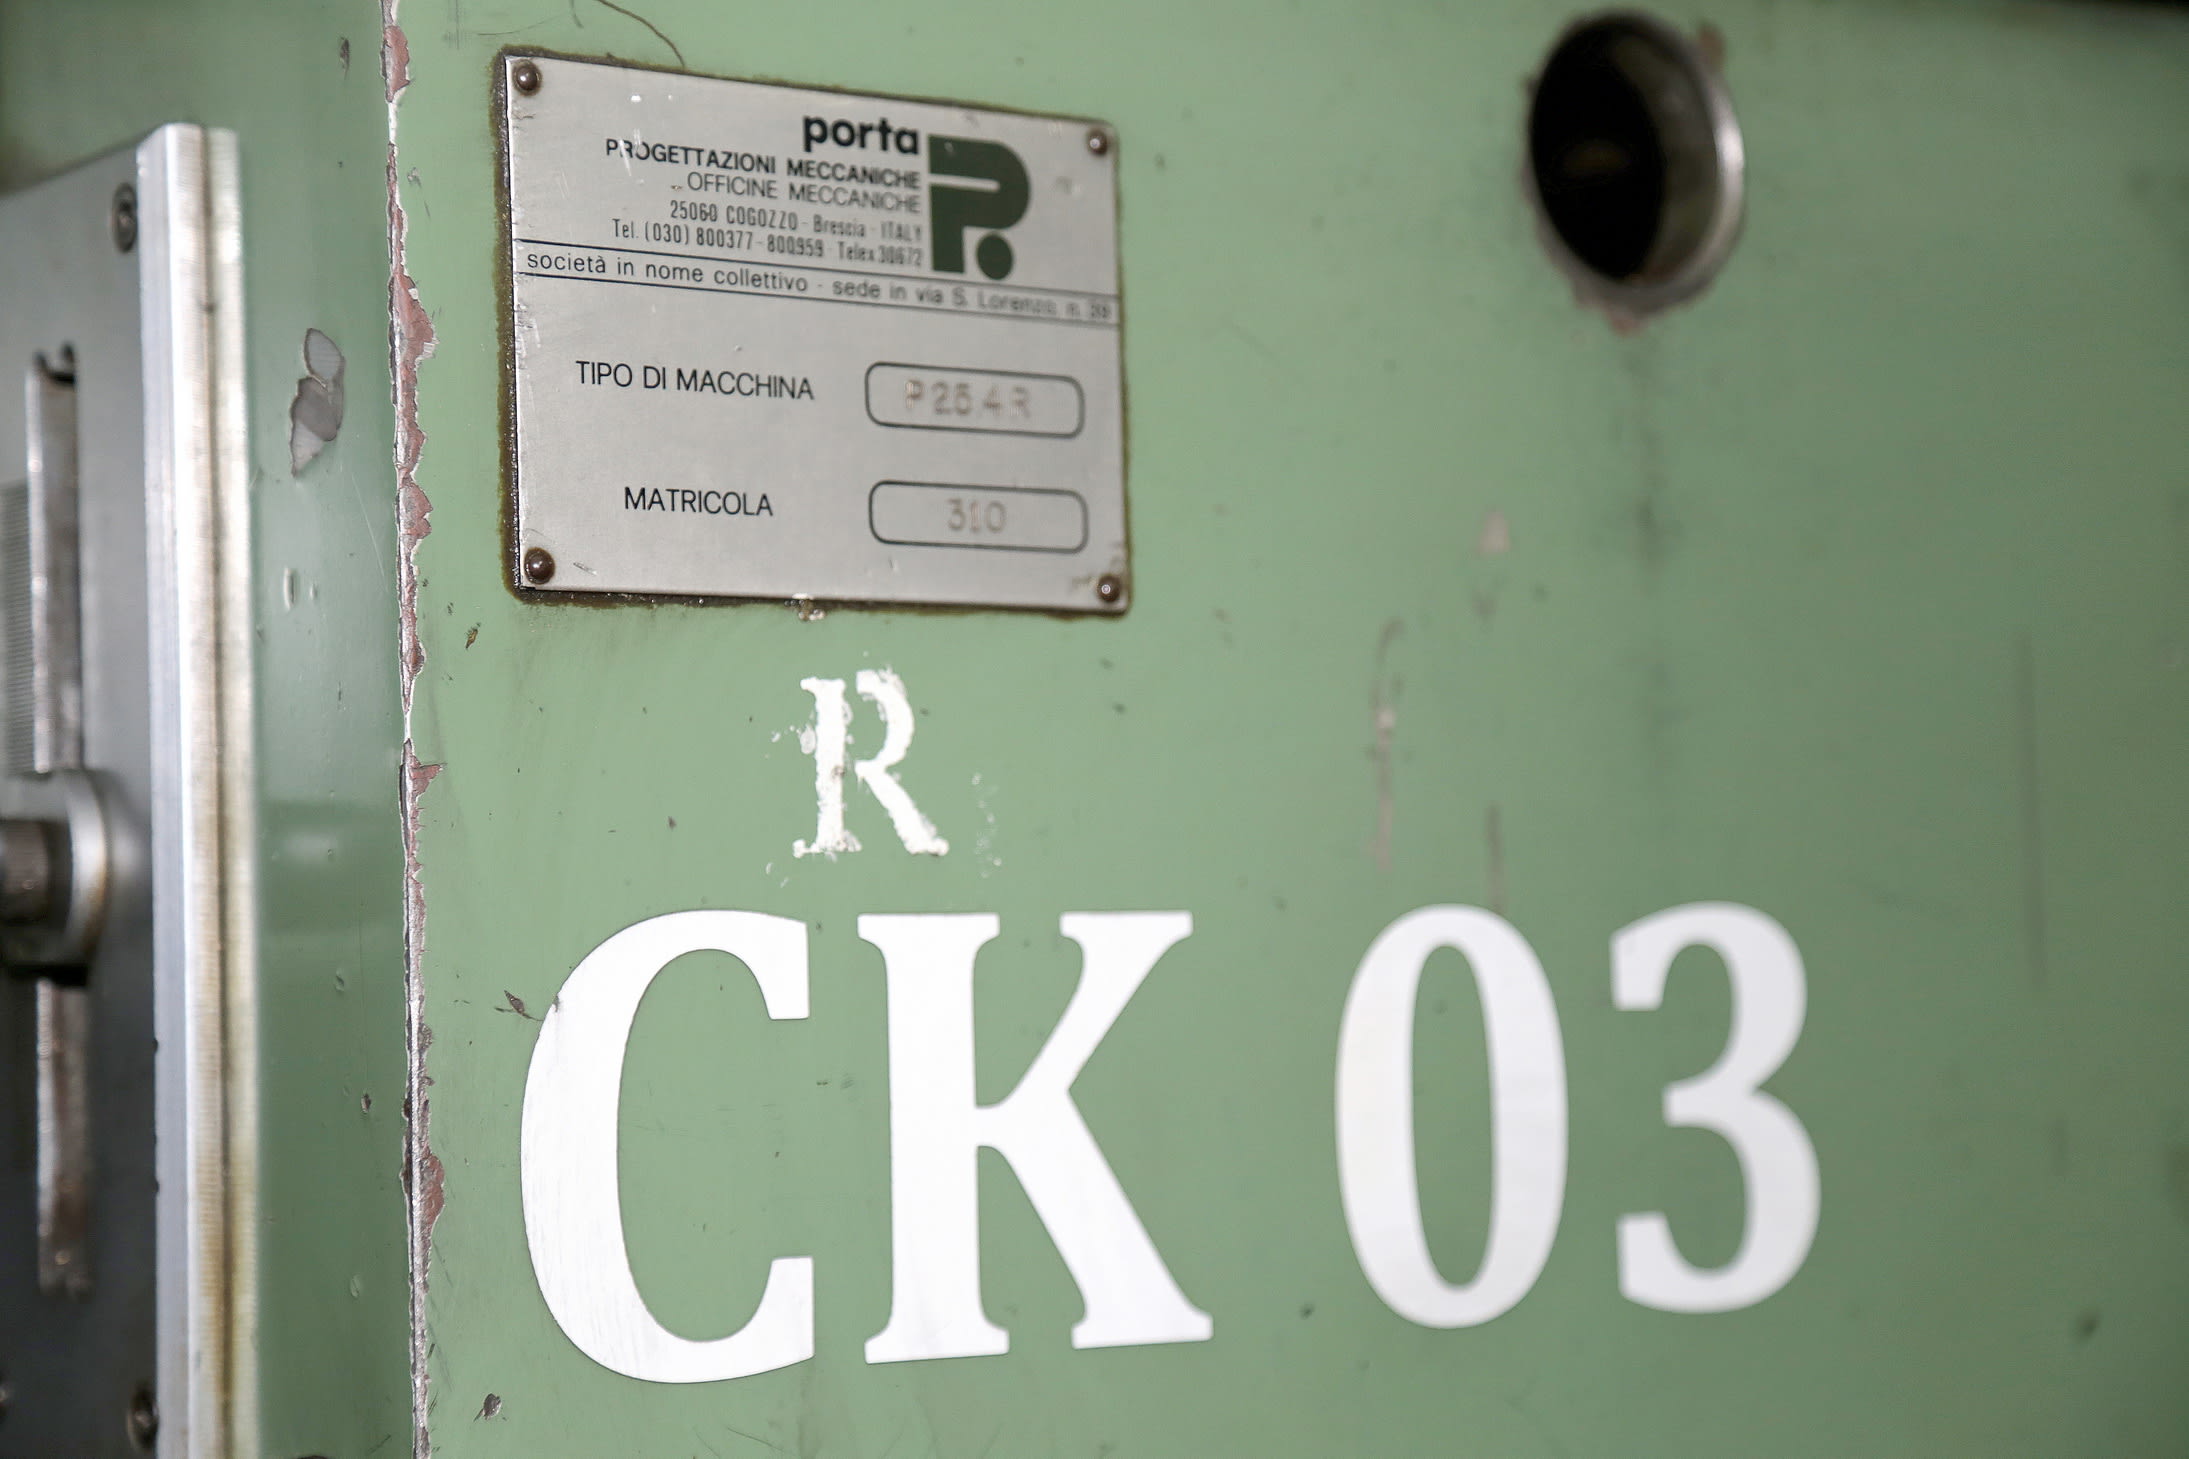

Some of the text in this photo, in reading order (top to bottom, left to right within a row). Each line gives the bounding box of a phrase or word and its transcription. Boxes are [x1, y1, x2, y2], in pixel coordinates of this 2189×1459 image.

[803, 115, 919, 155] porta
[606, 138, 921, 189] PROGETTAZIONI MECCANICHE
[687, 171, 921, 214] OFFICINE MECCANICHE
[612, 218, 639, 240] Tel.
[645, 221, 690, 245] (030)
[670, 199, 718, 222] 25060
[726, 205, 798, 231] COGOZZO
[813, 214, 867, 238] Brescia
[881, 220, 922, 242] ITALY
[527, 253, 606, 273] società
[617, 257, 635, 276] in
[646, 263, 704, 282] nome
[714, 267, 809, 292] collettivo
[832, 279, 881, 299] sede
[889, 282, 907, 300] in
[914, 284, 943, 304] via
[576, 360, 815, 400] TIPO DI MACCHINA
[624, 486, 773, 517] MATRICOLA
[948, 498, 1008, 533] 310
[793, 669, 949, 859] R
[520, 901, 1822, 1384] CK 03
